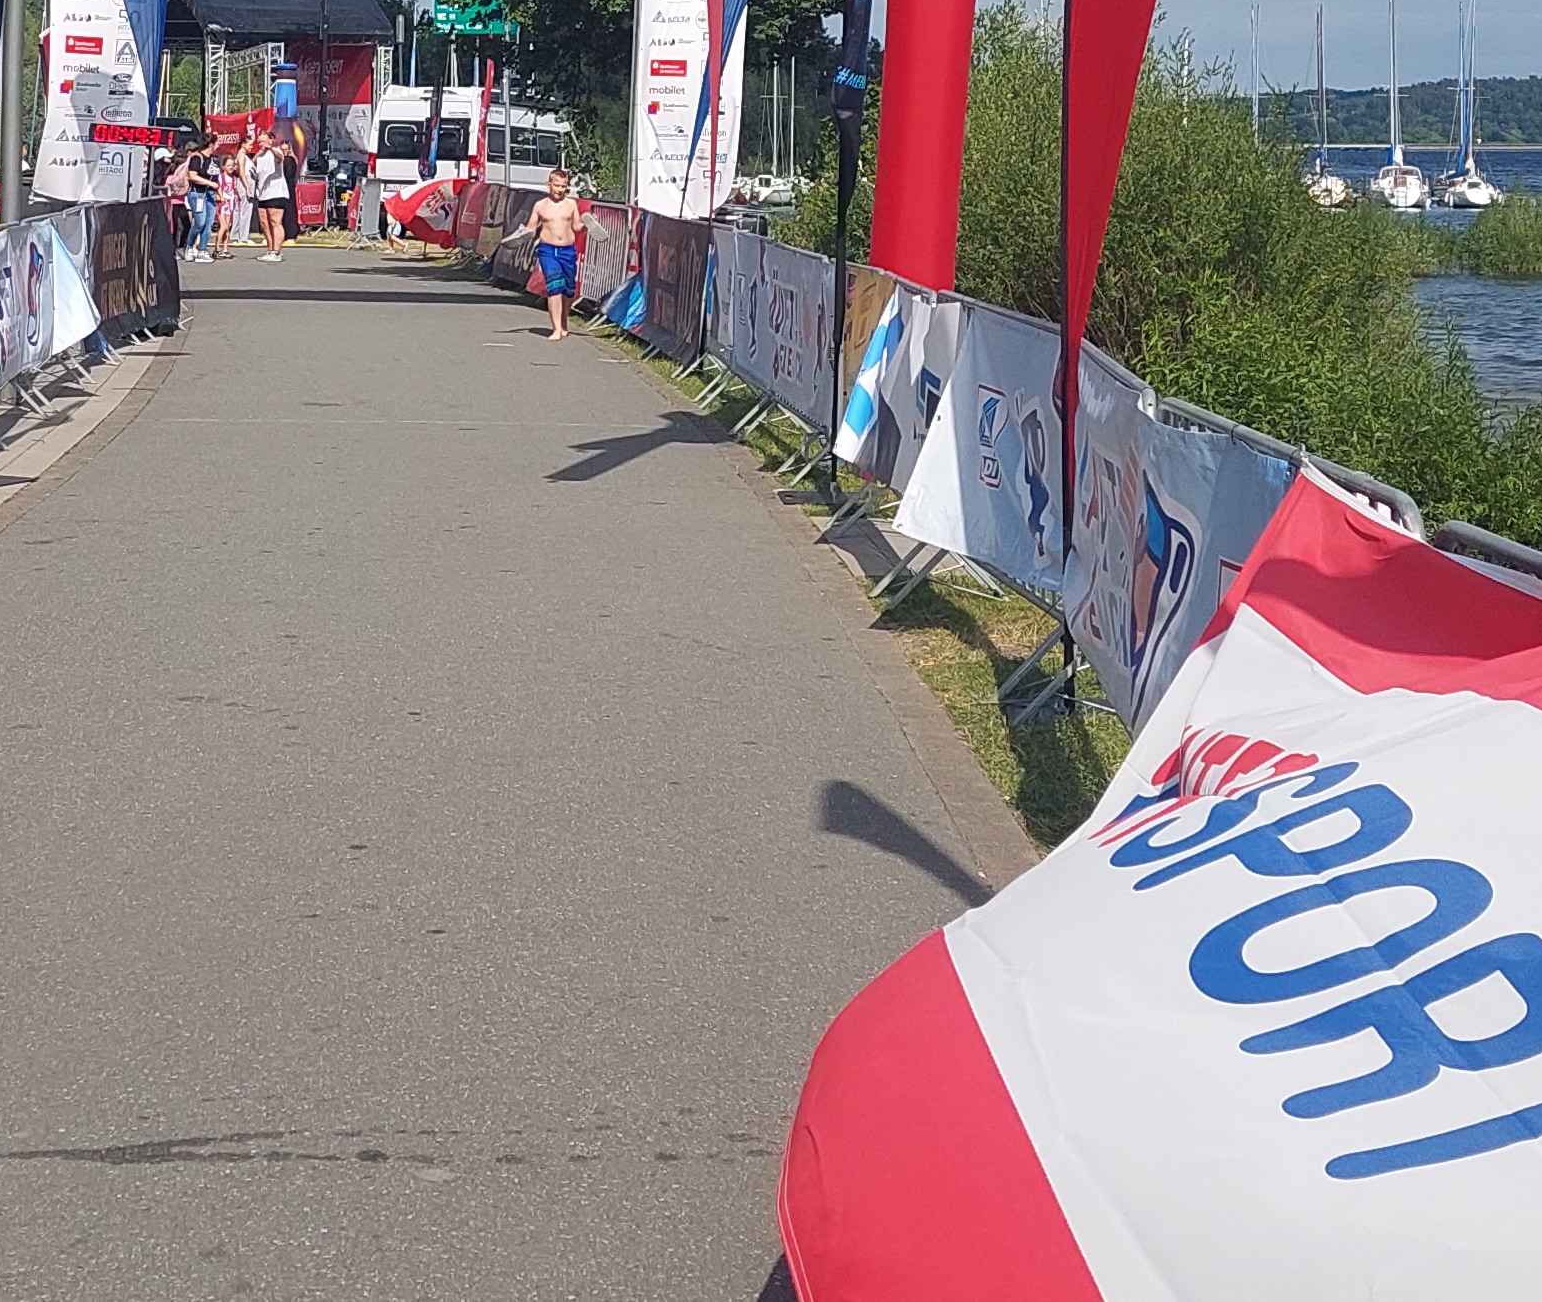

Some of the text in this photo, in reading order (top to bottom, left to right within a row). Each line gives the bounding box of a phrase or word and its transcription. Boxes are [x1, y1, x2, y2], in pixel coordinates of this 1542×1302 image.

[63, 63, 101, 74] mobilet
[649, 85, 687, 95] mobilet
[99, 151, 124, 166] 50
